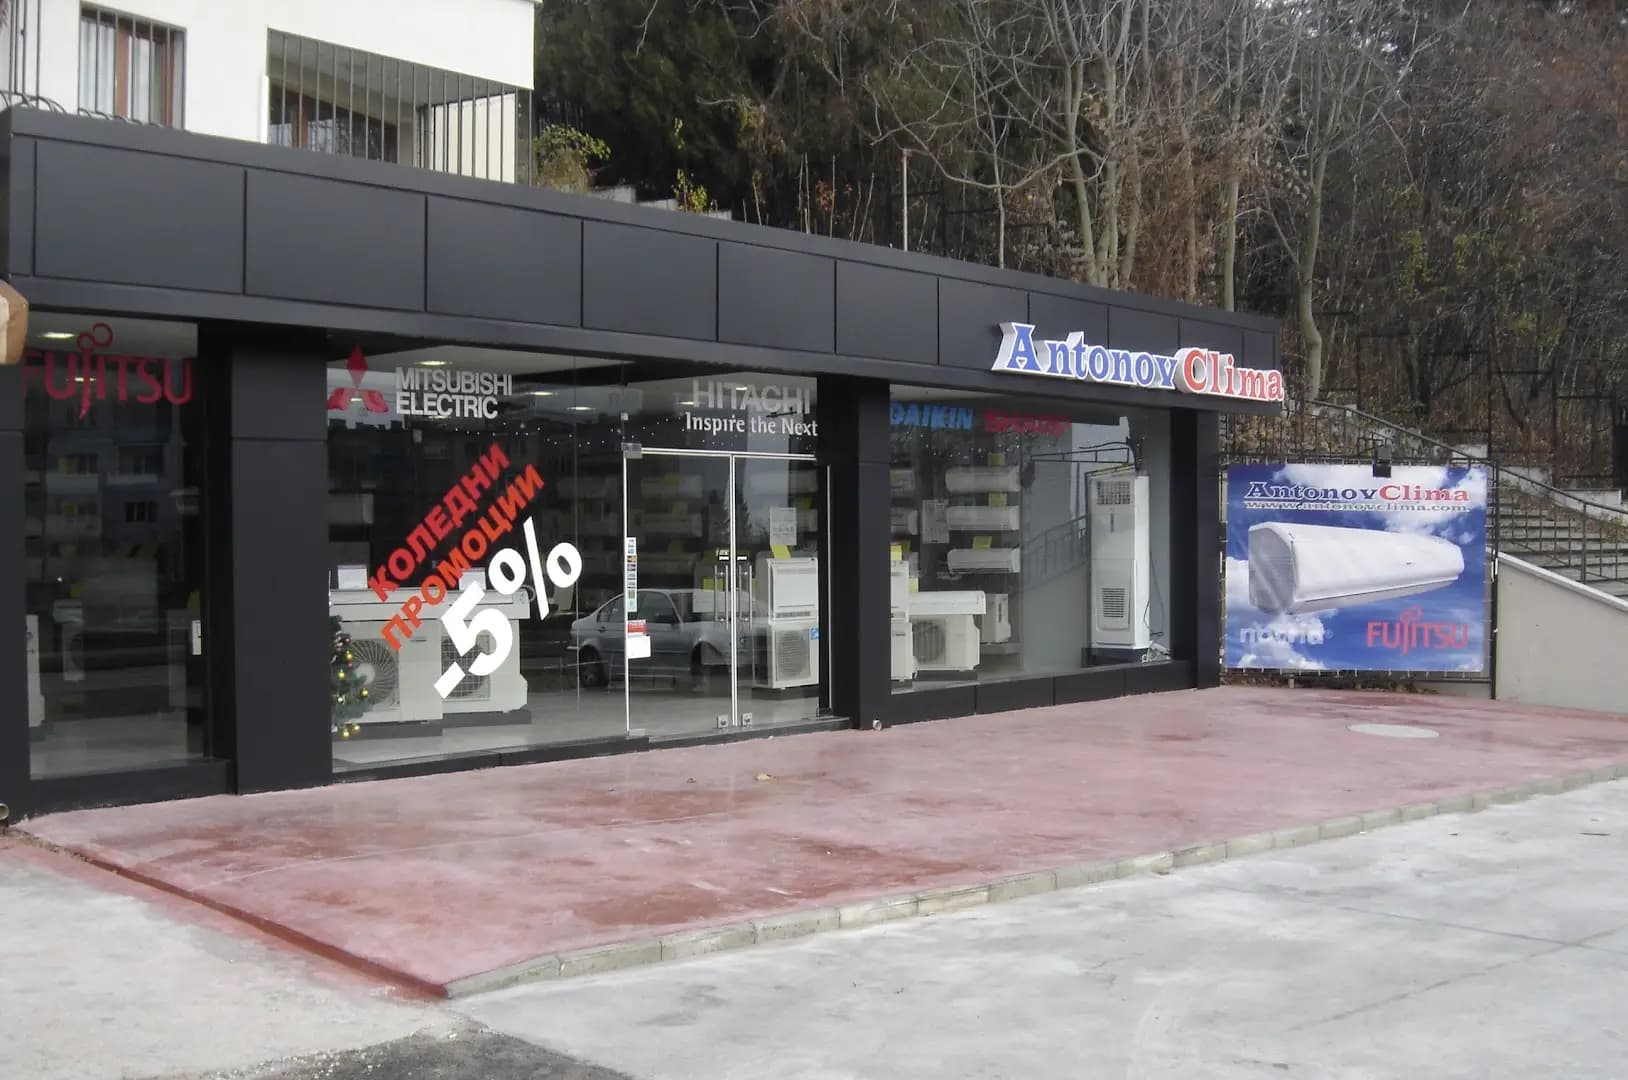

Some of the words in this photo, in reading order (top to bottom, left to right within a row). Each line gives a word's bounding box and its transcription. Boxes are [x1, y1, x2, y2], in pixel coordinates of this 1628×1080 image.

[395, 366, 513, 397] MITSUBISHI
[692, 379, 811, 415] HITACHI
[395, 394, 499, 419] ELECTRIC
[890, 400, 975, 431] DAIKIN
[686, 412, 746, 434] Inspire
[750, 415, 776, 434] the
[781, 419, 819, 437] Next
[367, 442, 511, 603] КОЛЕДНИ
[1246, 500, 1468, 512] www.antonovclima.com
[380, 463, 545, 652] ПРОМОЦИИ
[433, 517, 583, 699] -5%
[1366, 606, 1469, 656] FUJITSU
